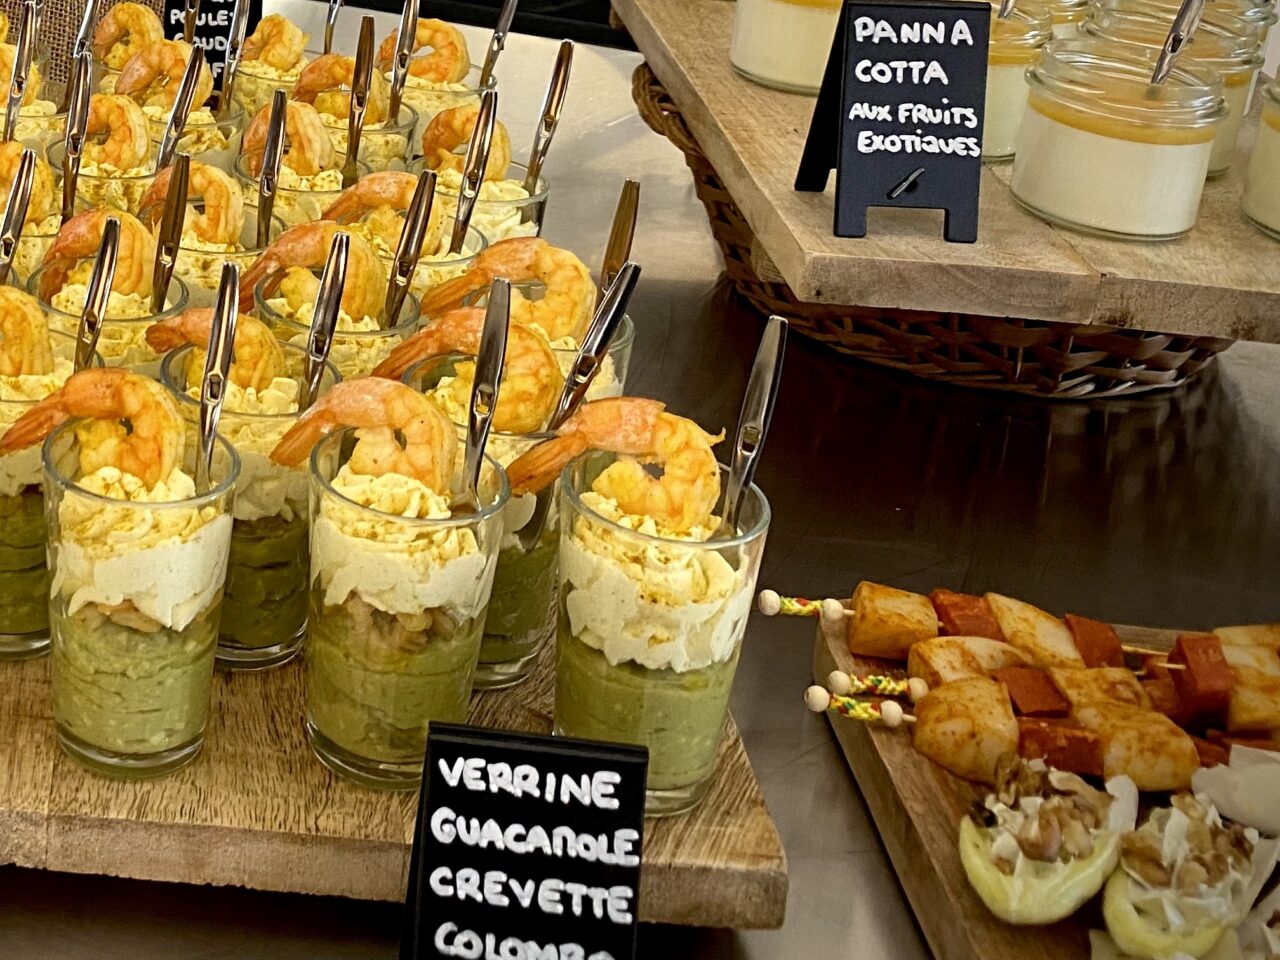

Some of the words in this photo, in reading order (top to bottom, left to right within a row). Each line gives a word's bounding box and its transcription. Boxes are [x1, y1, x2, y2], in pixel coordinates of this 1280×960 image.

[854, 16, 973, 45] PANNA
[855, 59, 949, 85] COTTA
[849, 103, 892, 121] AUX
[438, 756, 621, 810] VERRINE
[431, 806, 640, 867] GUACAMOLE
[429, 866, 634, 924] CREVETTE
[434, 921, 618, 960] COLOMB
